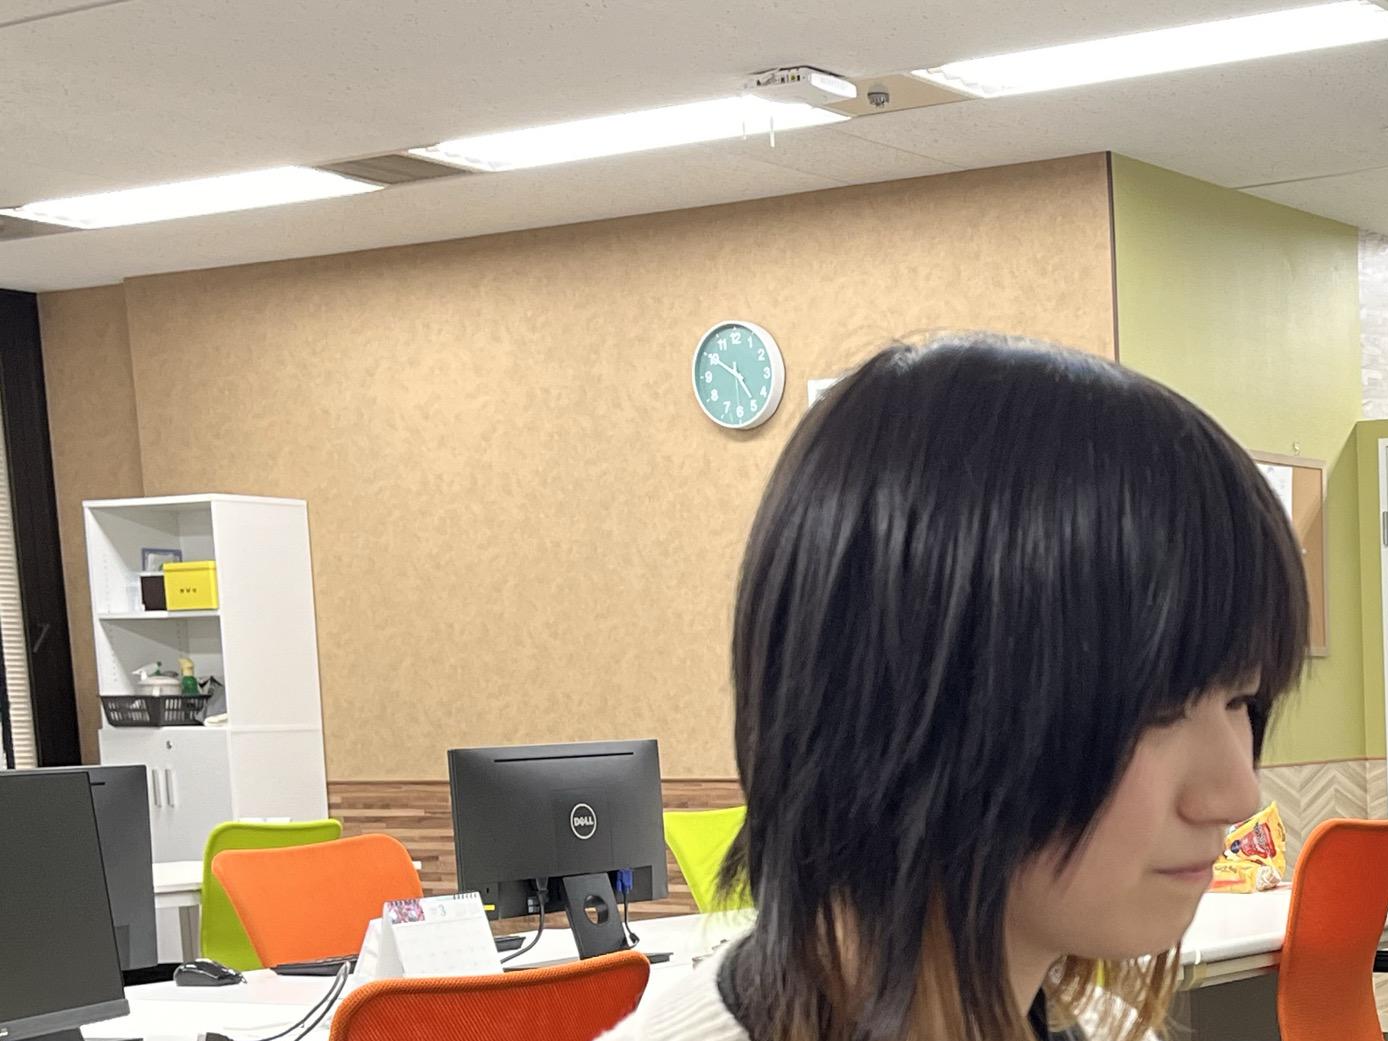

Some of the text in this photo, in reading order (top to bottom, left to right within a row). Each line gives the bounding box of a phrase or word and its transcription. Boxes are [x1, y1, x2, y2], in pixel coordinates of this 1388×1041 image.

[730, 332, 741, 344] 12
[748, 337, 752, 348] 1
[717, 339, 727, 350] 11
[758, 349, 765, 361] 2
[705, 371, 712, 383] 9
[763, 368, 770, 379] 3
[711, 389, 718, 401] 8
[760, 386, 767, 398] 4
[723, 402, 730, 414] 7
[736, 406, 743, 418] 6
[750, 400, 757, 412] 5
[574, 816, 594, 826] DELL
